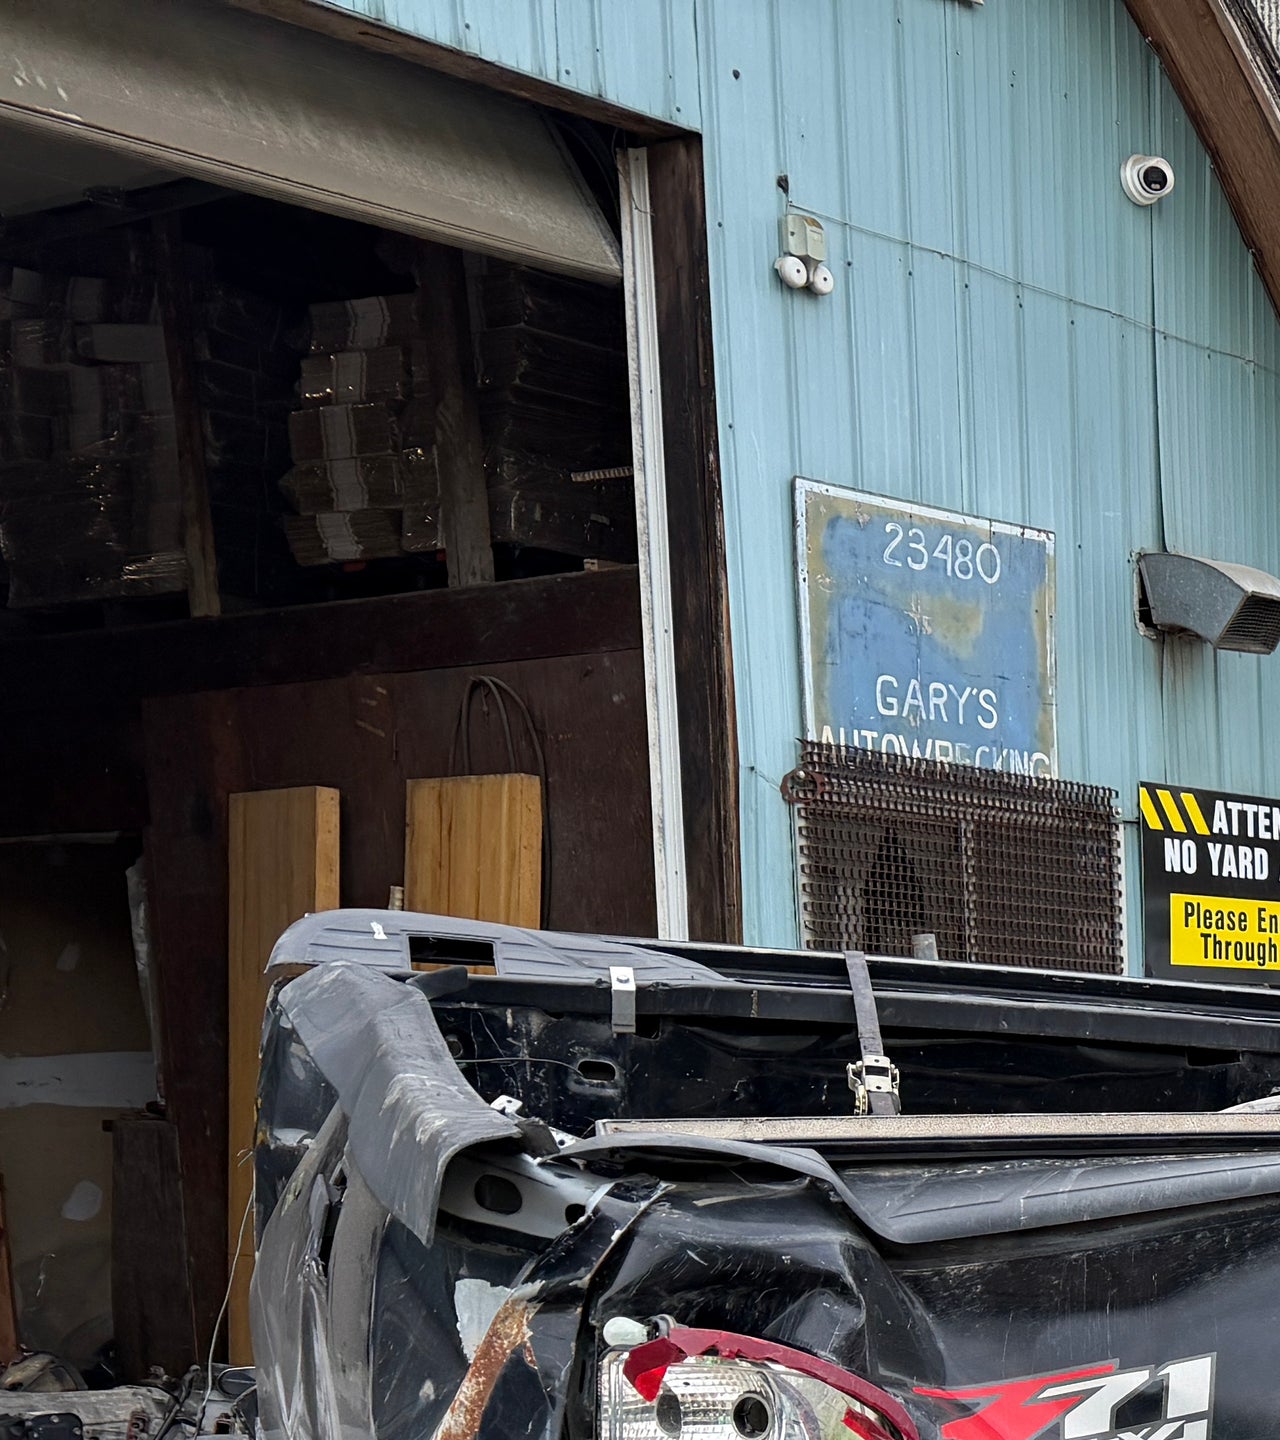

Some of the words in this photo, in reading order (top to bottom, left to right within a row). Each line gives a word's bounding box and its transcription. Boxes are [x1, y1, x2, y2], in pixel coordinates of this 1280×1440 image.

[883, 522, 1001, 584] 23480
[876, 674, 998, 730] GARY'S
[1163, 837, 1197, 875] NO
[1207, 842, 1269, 881] YARD
[1184, 901, 1248, 932] Please
[1200, 932, 1278, 967] Through
